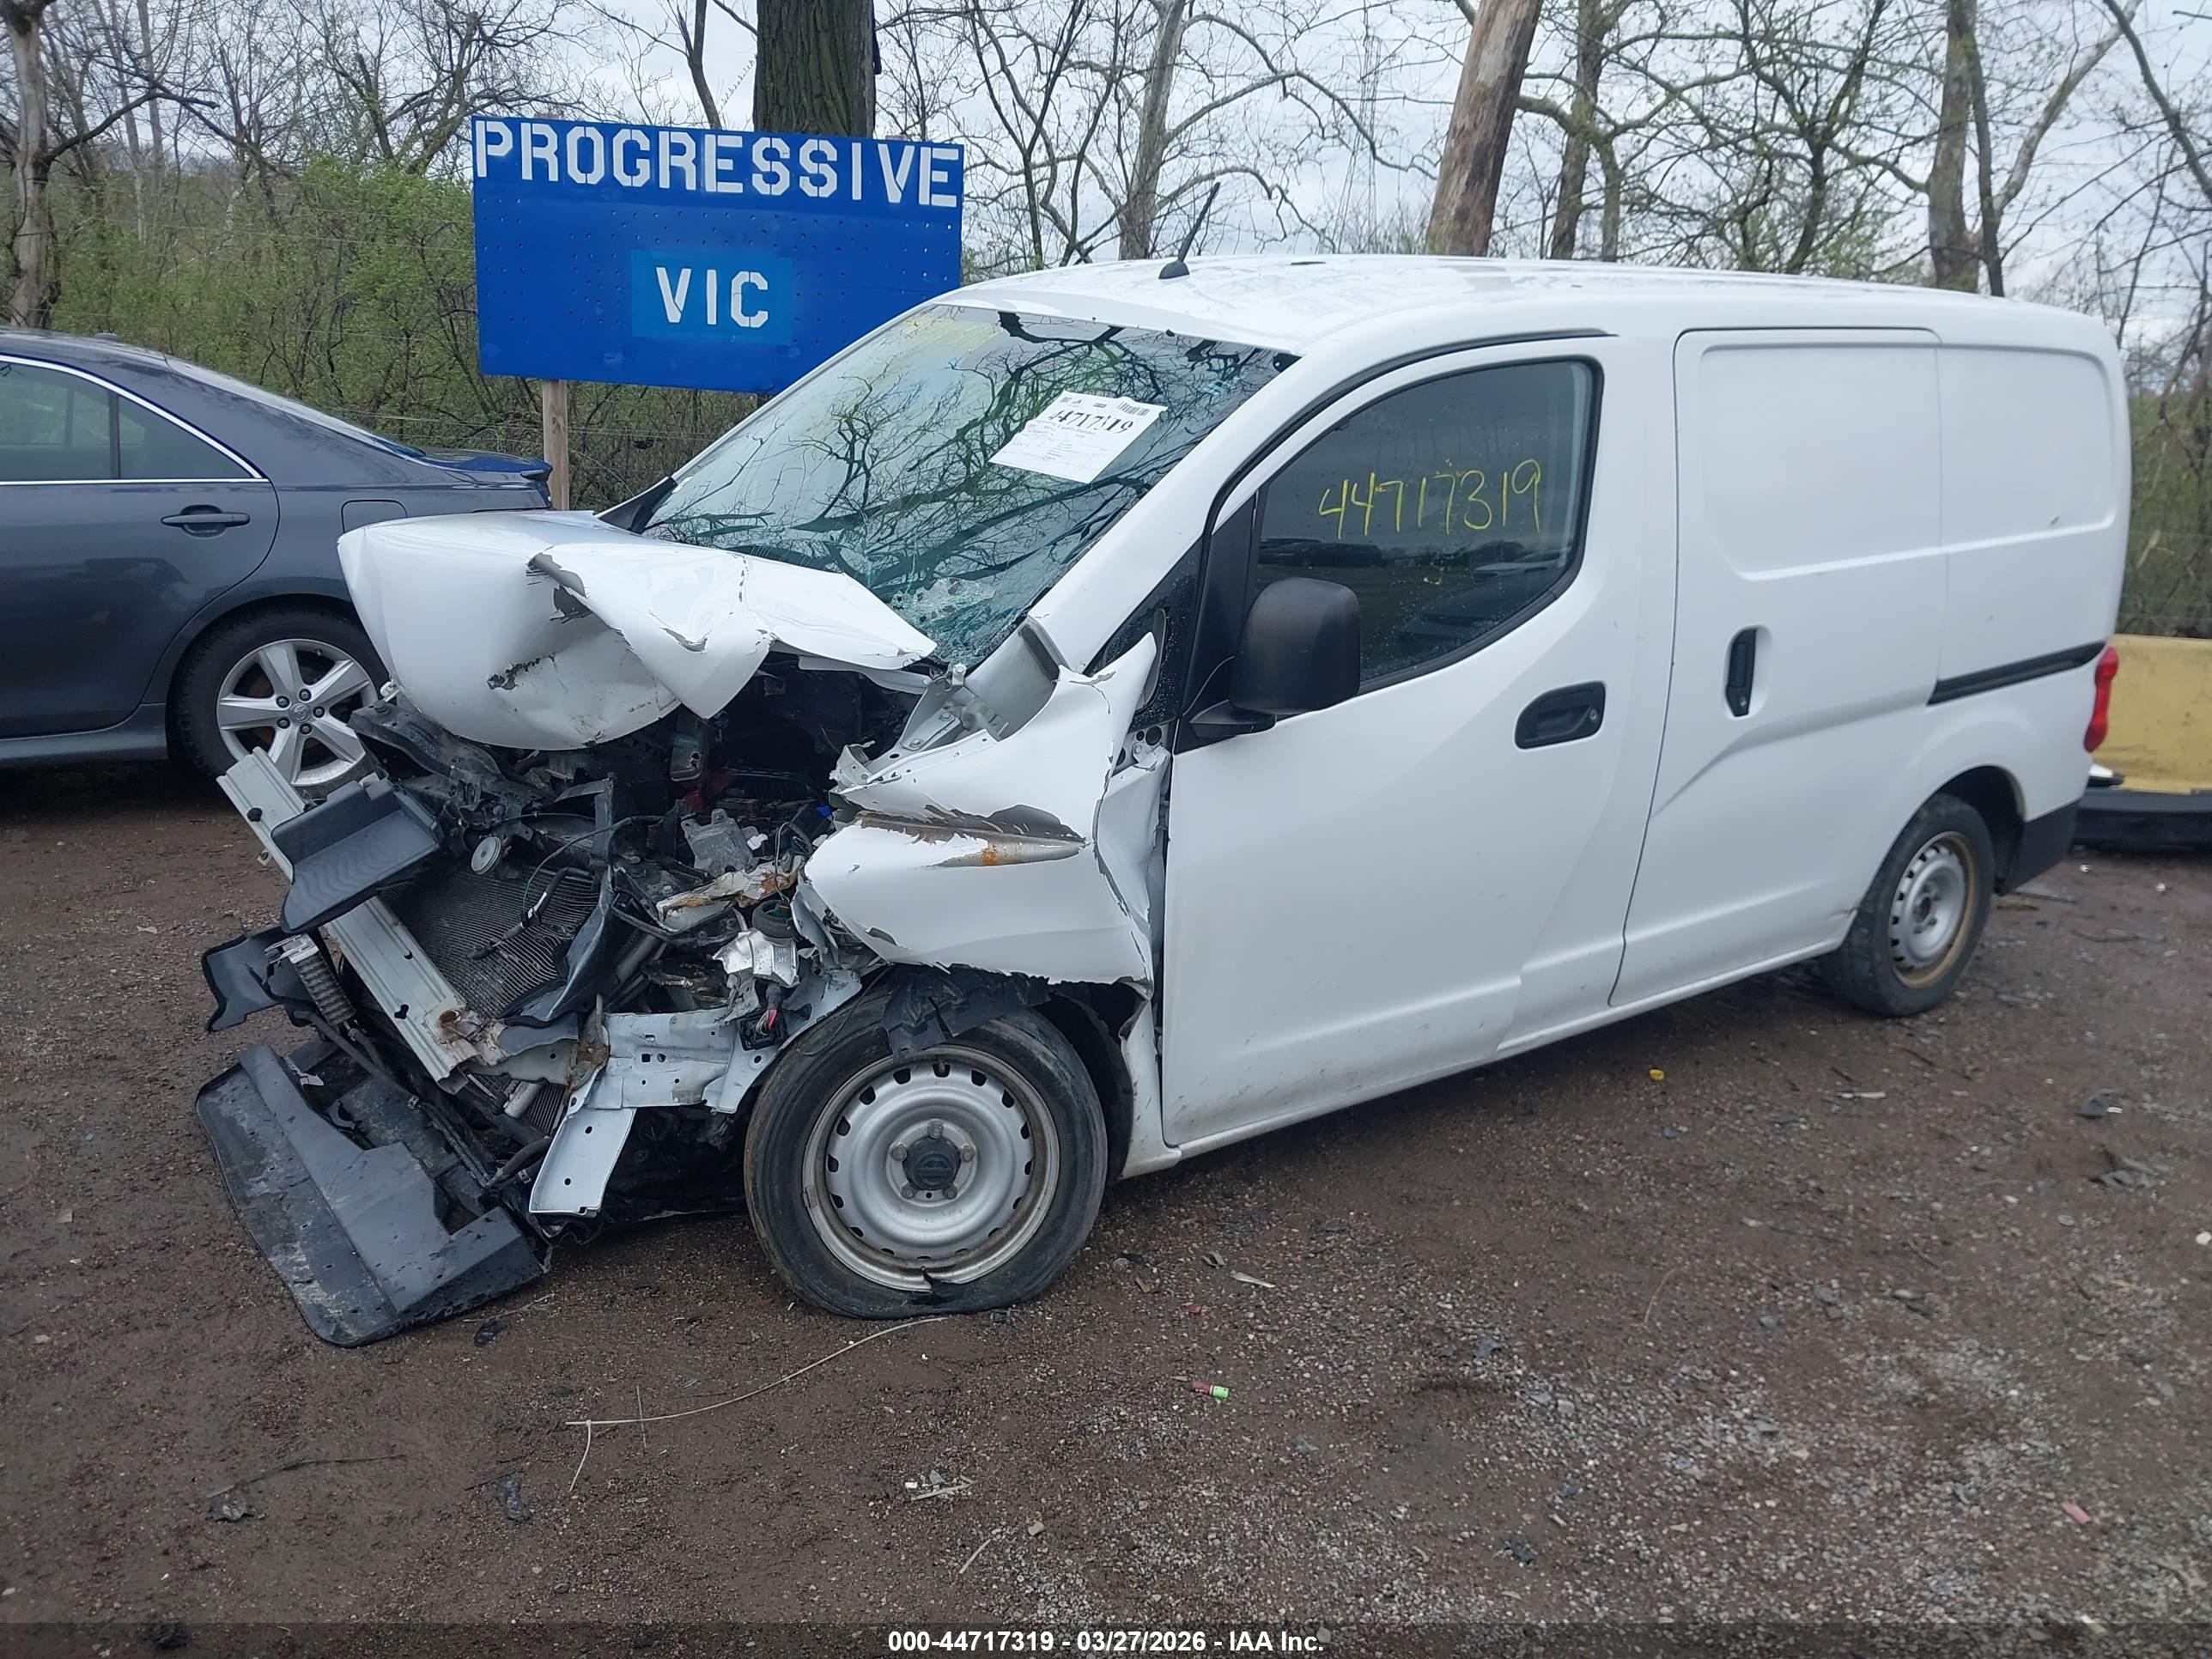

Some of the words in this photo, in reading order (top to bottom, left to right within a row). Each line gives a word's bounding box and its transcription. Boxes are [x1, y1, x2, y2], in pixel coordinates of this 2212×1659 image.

[475, 120, 959, 208] PROGRESSIVE
[655, 266, 769, 328] VIC
[1318, 459, 1541, 540] 44717319
